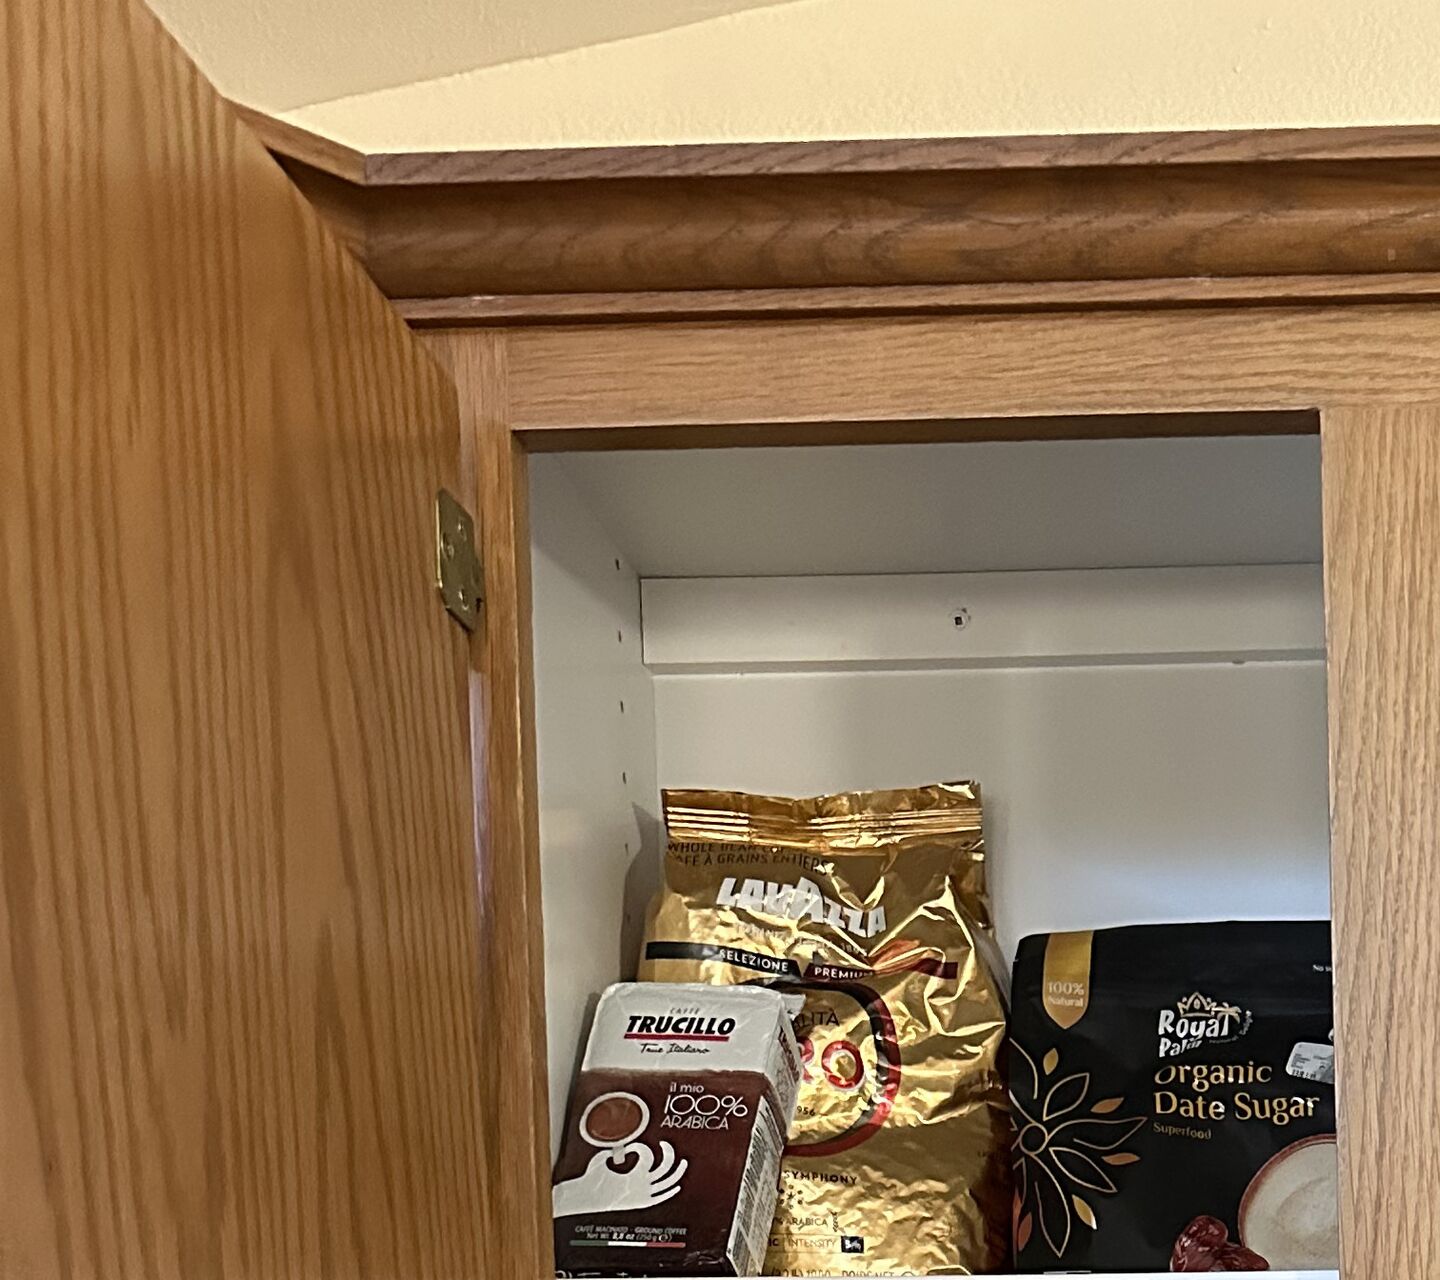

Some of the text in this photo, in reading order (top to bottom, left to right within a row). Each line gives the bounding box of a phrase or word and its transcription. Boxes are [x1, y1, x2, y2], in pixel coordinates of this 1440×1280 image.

[717, 853, 769, 865] GRAINS
[716, 876, 887, 938] LAVAZZA
[719, 948, 789, 972] SELEZIONE
[1048, 981, 1085, 996] 100%
[626, 1015, 736, 1036] TRUCILLO
[1158, 1009, 1229, 1040] Royal
[640, 1043, 664, 1054] True
[670, 1081, 705, 1094] il mio
[664, 1094, 749, 1118] 100%
[796, 1105, 816, 1117] 956
[1153, 1091, 1321, 1126] Date Sugar
[660, 1115, 729, 1131] ARABICA
[1153, 1122, 1212, 1140] Superfood
[783, 1170, 858, 1185] SYMPHONY
[786, 1217, 829, 1228] ARABICA
[634, 1227, 664, 1235] GROUND
[664, 1227, 688, 1236] COFFEE
[788, 1238, 838, 1249] INTENSITY
